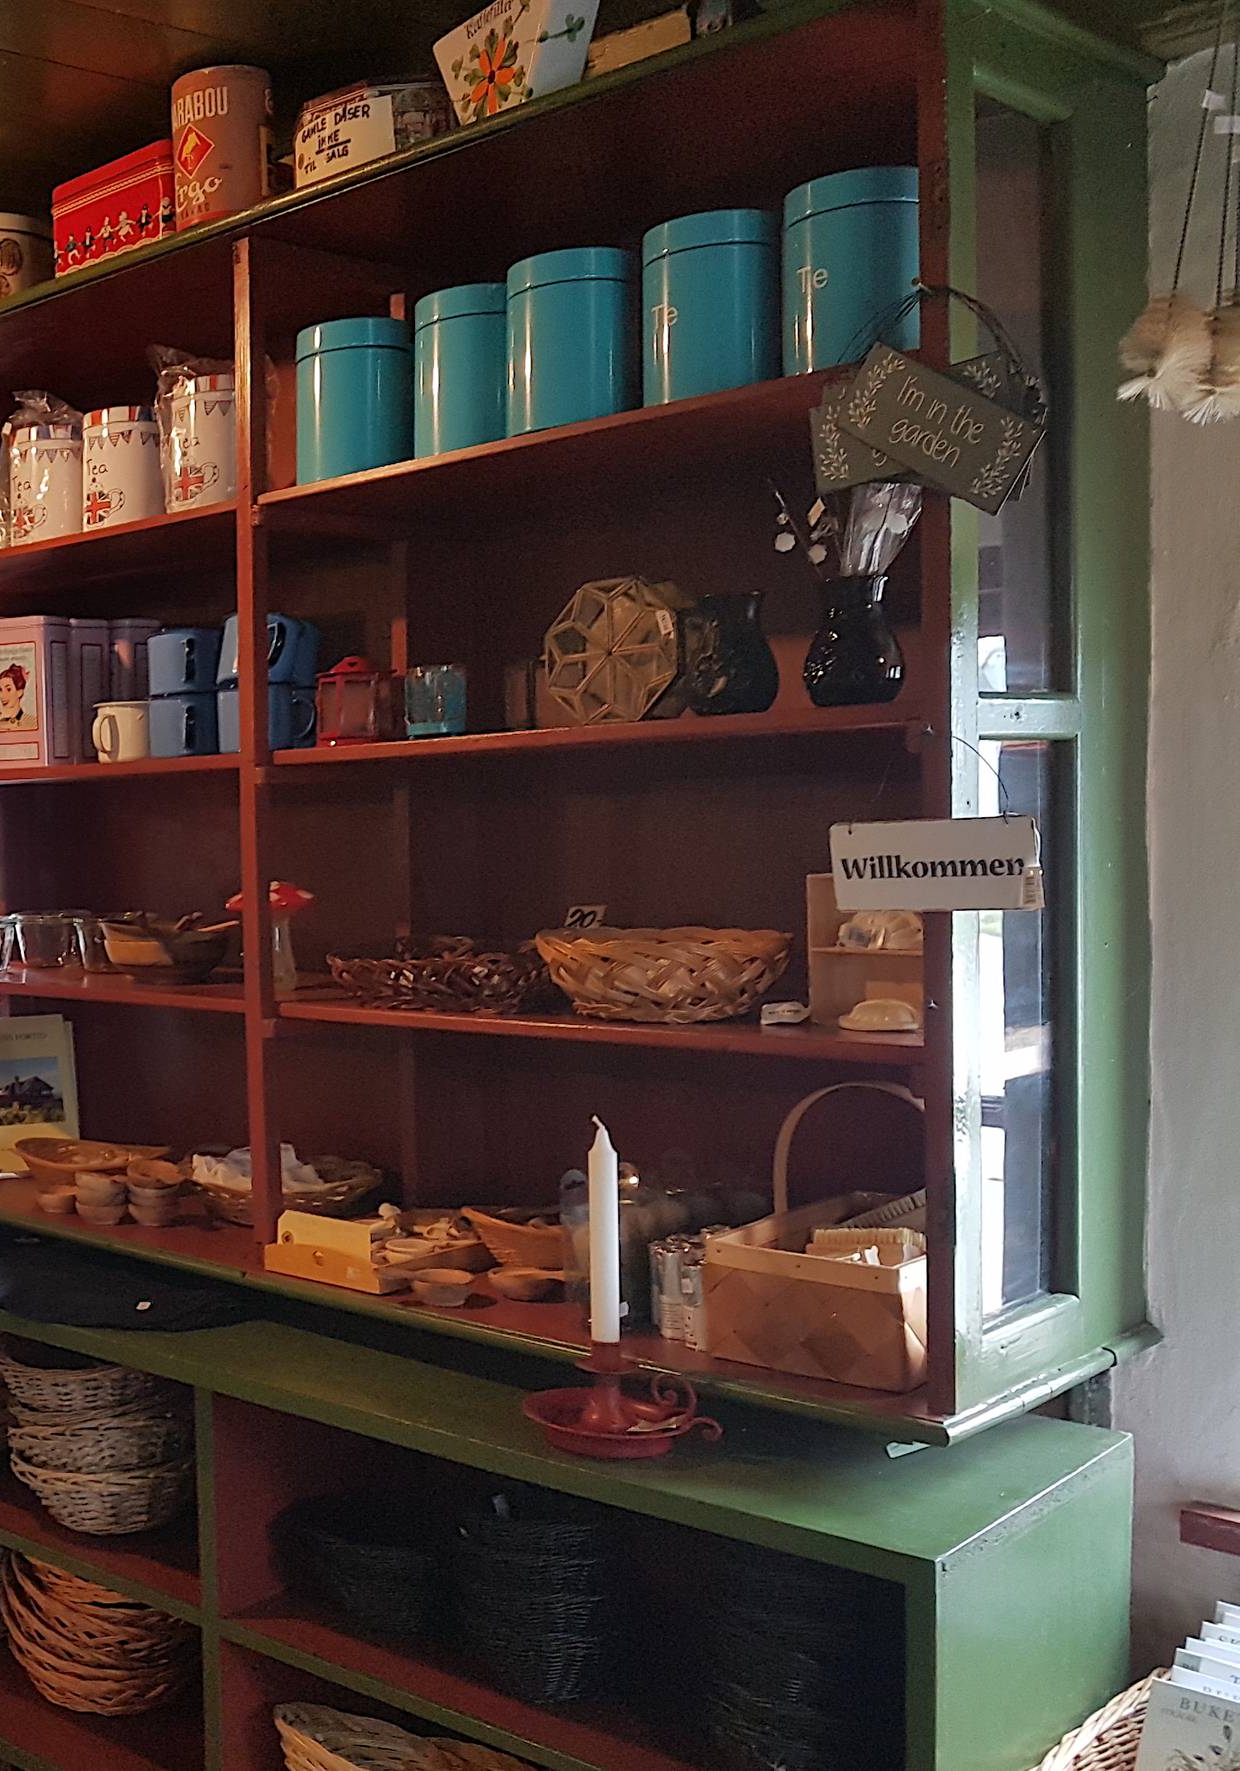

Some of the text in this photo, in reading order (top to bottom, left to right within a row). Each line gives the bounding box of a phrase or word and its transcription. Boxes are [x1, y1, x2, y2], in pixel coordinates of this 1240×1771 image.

[796, 266, 829, 293] Te
[651, 303, 679, 330] Te
[950, 404, 985, 444] the
[888, 417, 961, 468] garden
[86, 457, 109, 475] Tea
[12, 475, 32, 493] Tea
[841, 854, 1025, 880] Willkommen
[1178, 1696, 1240, 1724] BUKE
